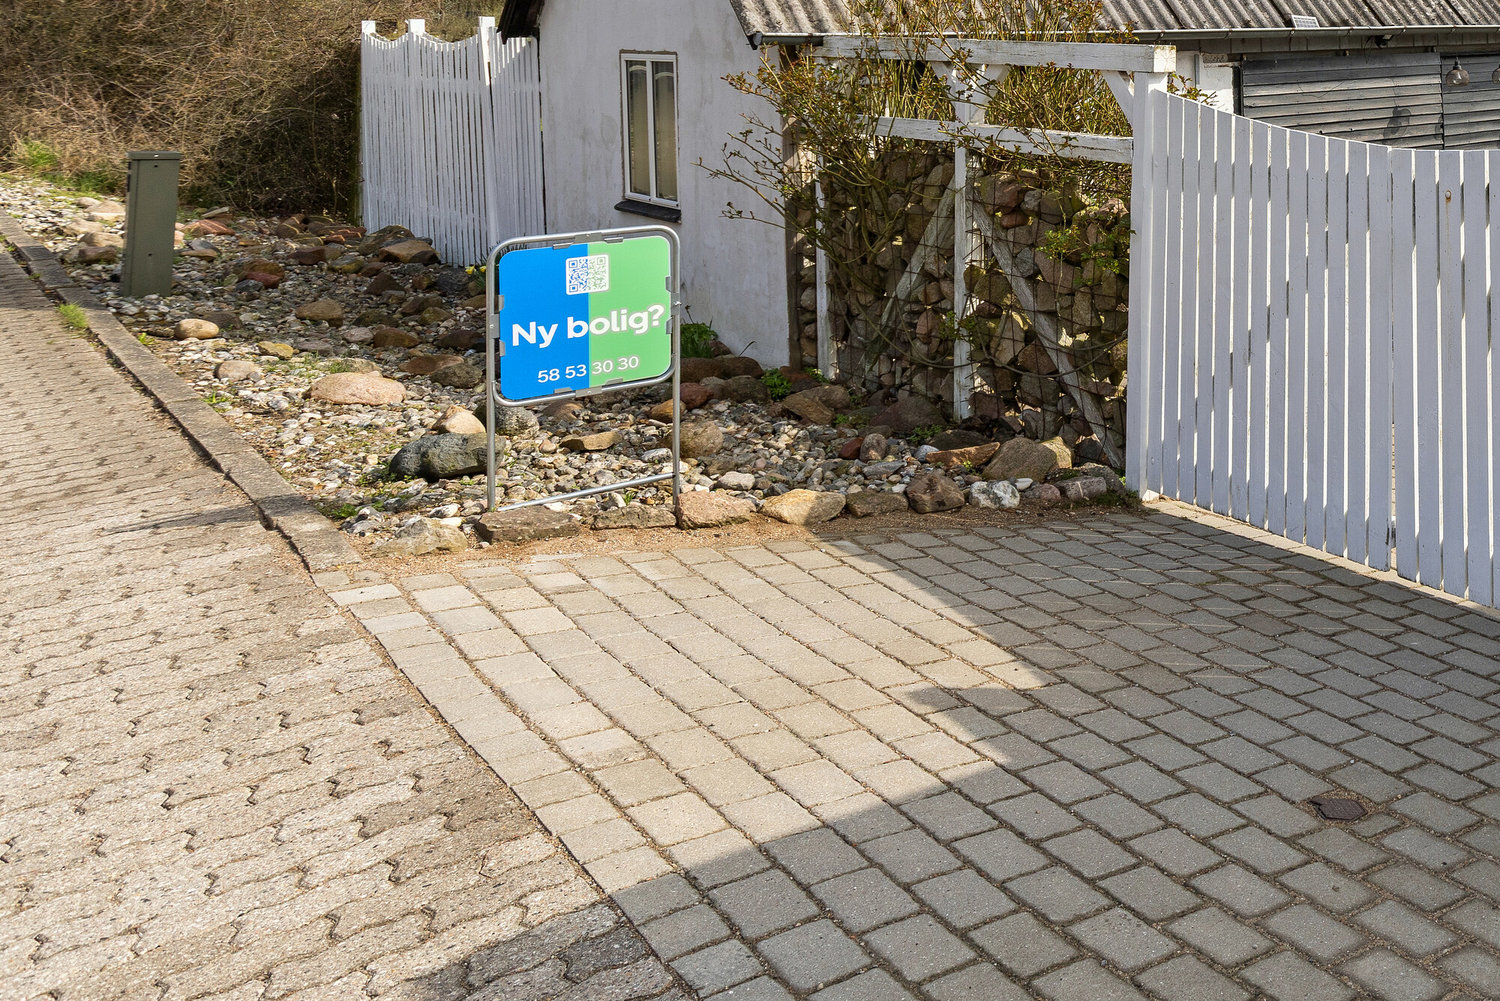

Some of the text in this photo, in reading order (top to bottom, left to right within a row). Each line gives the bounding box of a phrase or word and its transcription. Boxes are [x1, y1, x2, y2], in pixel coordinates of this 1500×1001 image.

[512, 304, 665, 349] Ny bolig?
[537, 356, 639, 383] 58 53 30 30
